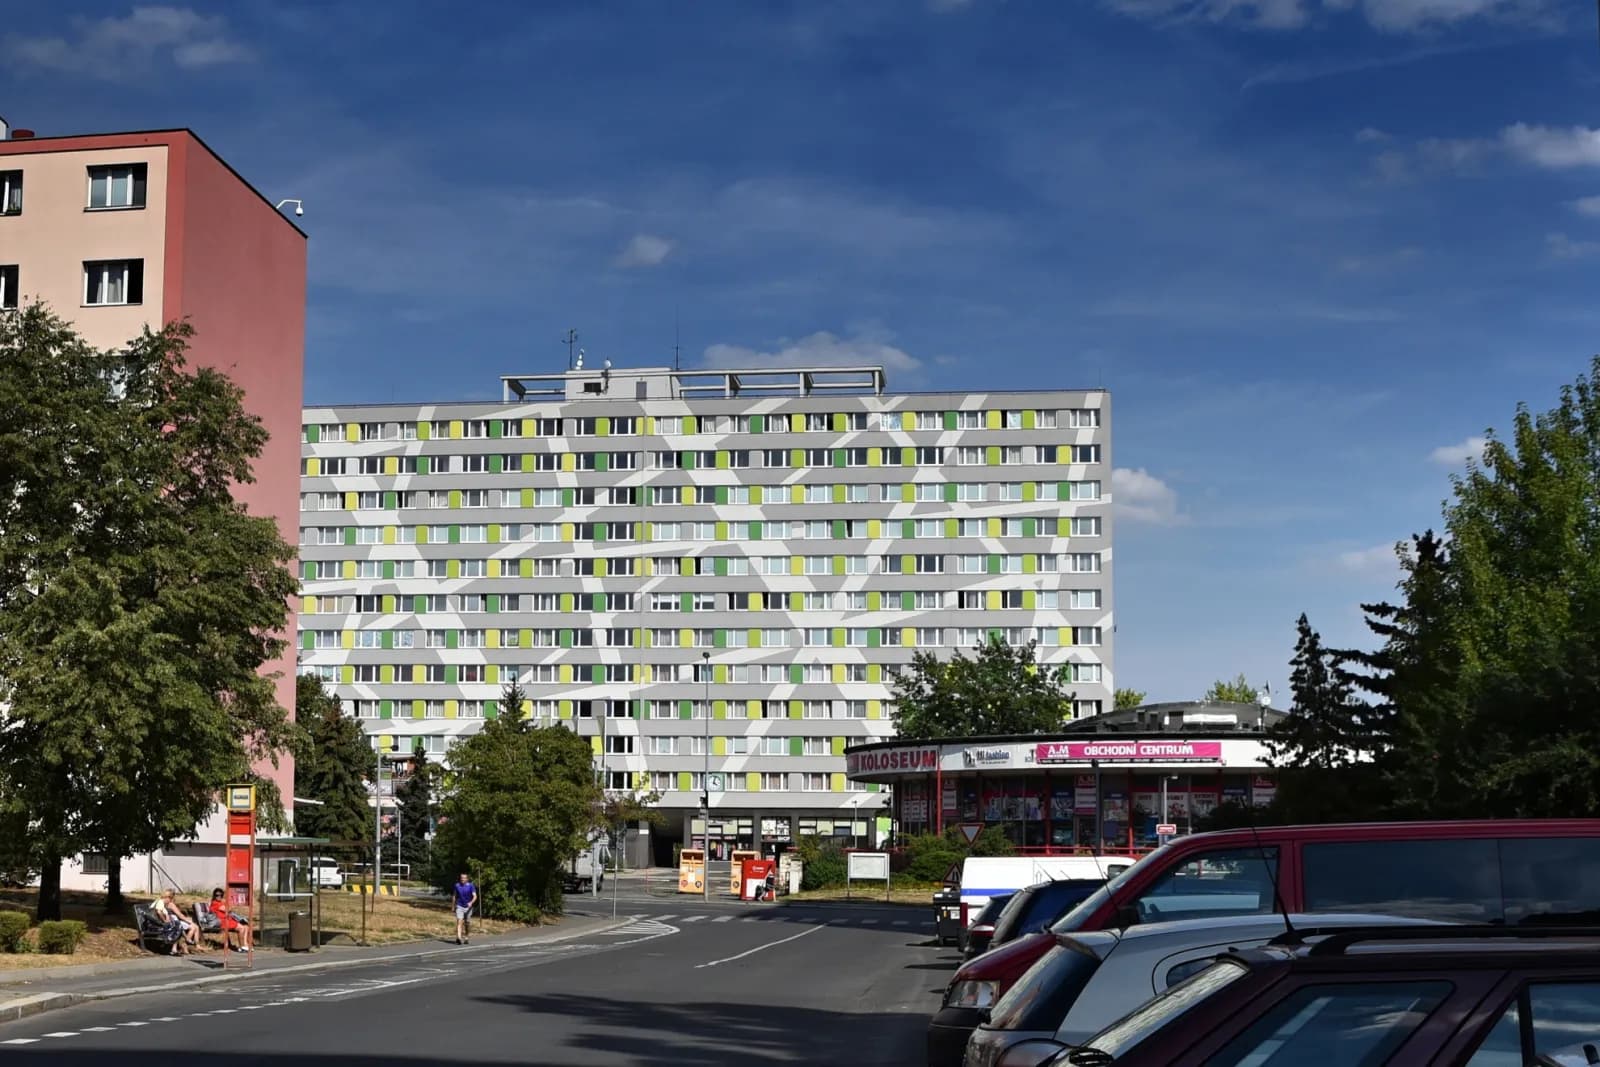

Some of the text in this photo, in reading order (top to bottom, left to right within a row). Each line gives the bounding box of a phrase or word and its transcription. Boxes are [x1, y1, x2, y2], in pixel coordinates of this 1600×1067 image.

[1084, 744, 1137, 756] OBCHODNÍ
[1140, 745, 1194, 755] CENTRUM
[861, 750, 937, 771] KOLOSEUM
